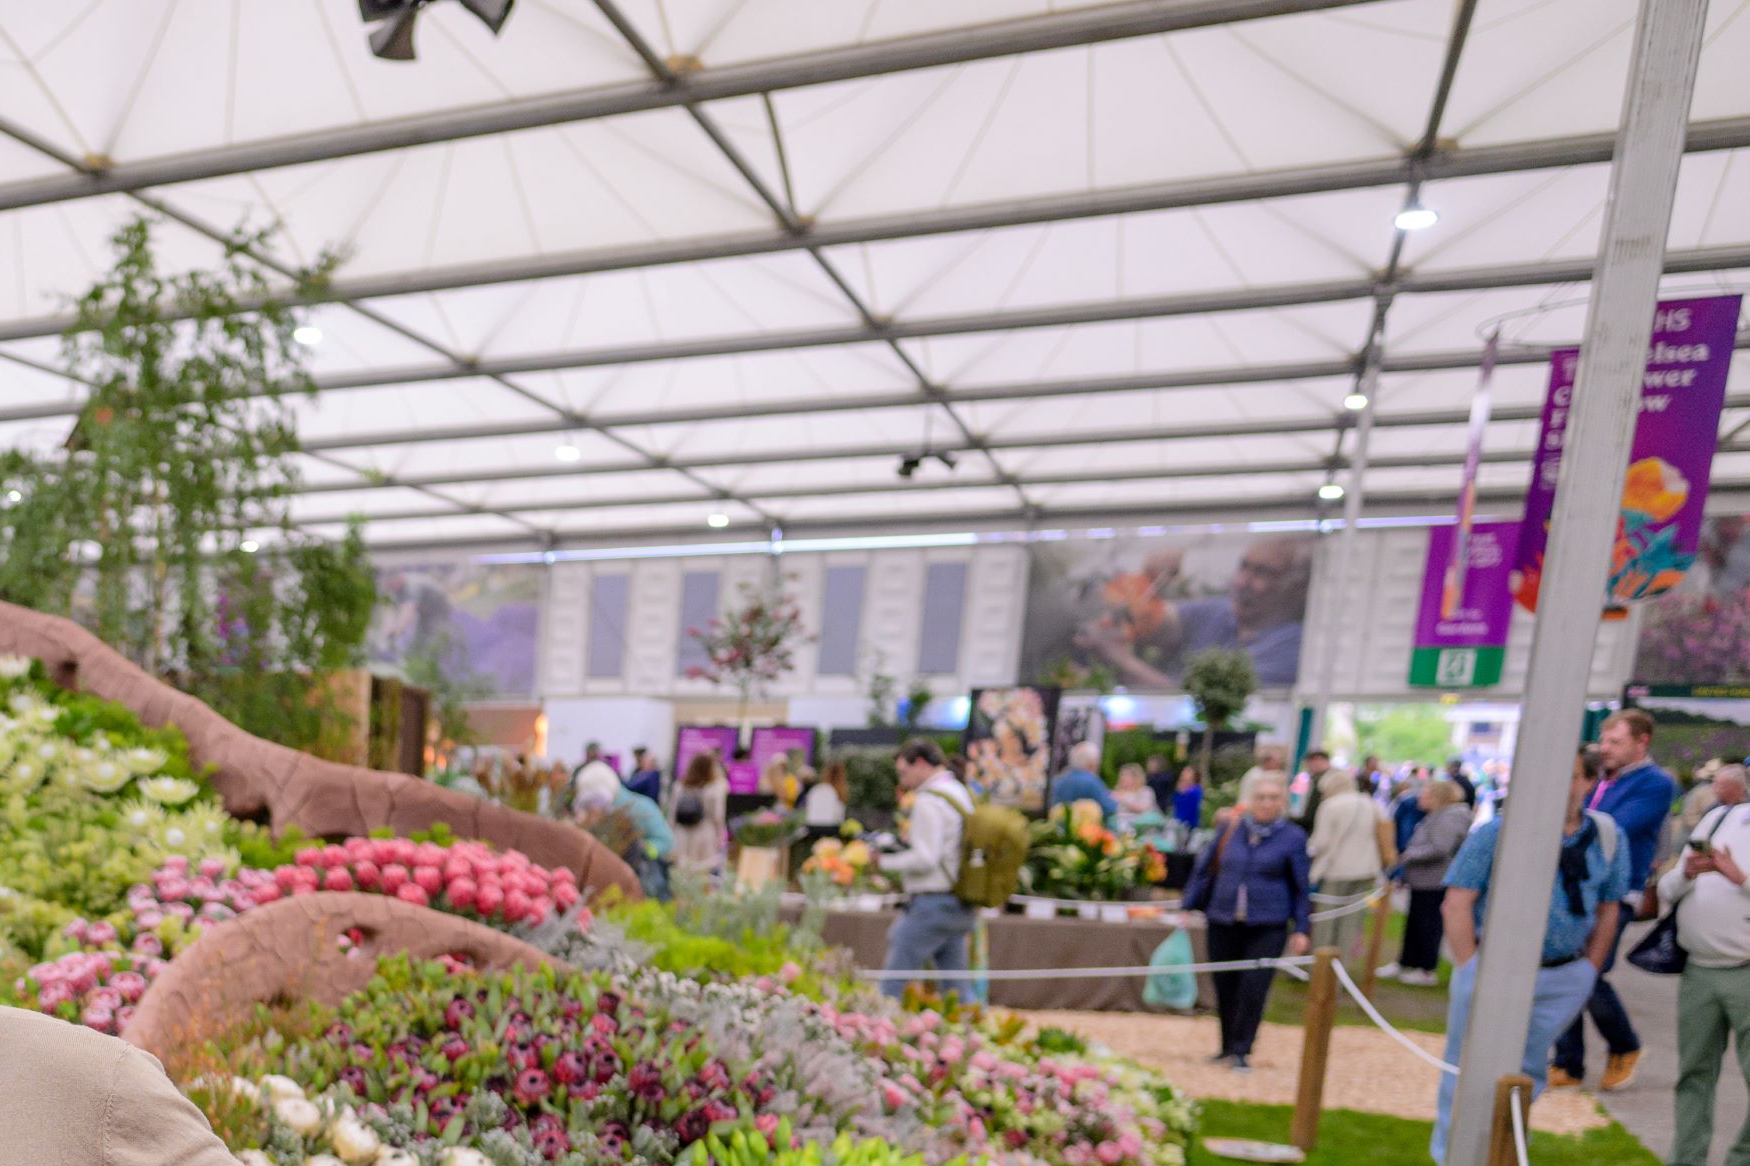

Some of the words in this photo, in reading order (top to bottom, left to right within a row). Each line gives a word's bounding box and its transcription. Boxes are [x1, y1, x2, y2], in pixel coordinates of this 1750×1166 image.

[1654, 308, 1691, 332] HS
[1647, 341, 1710, 364] elsea
[1643, 368, 1697, 388] wer
